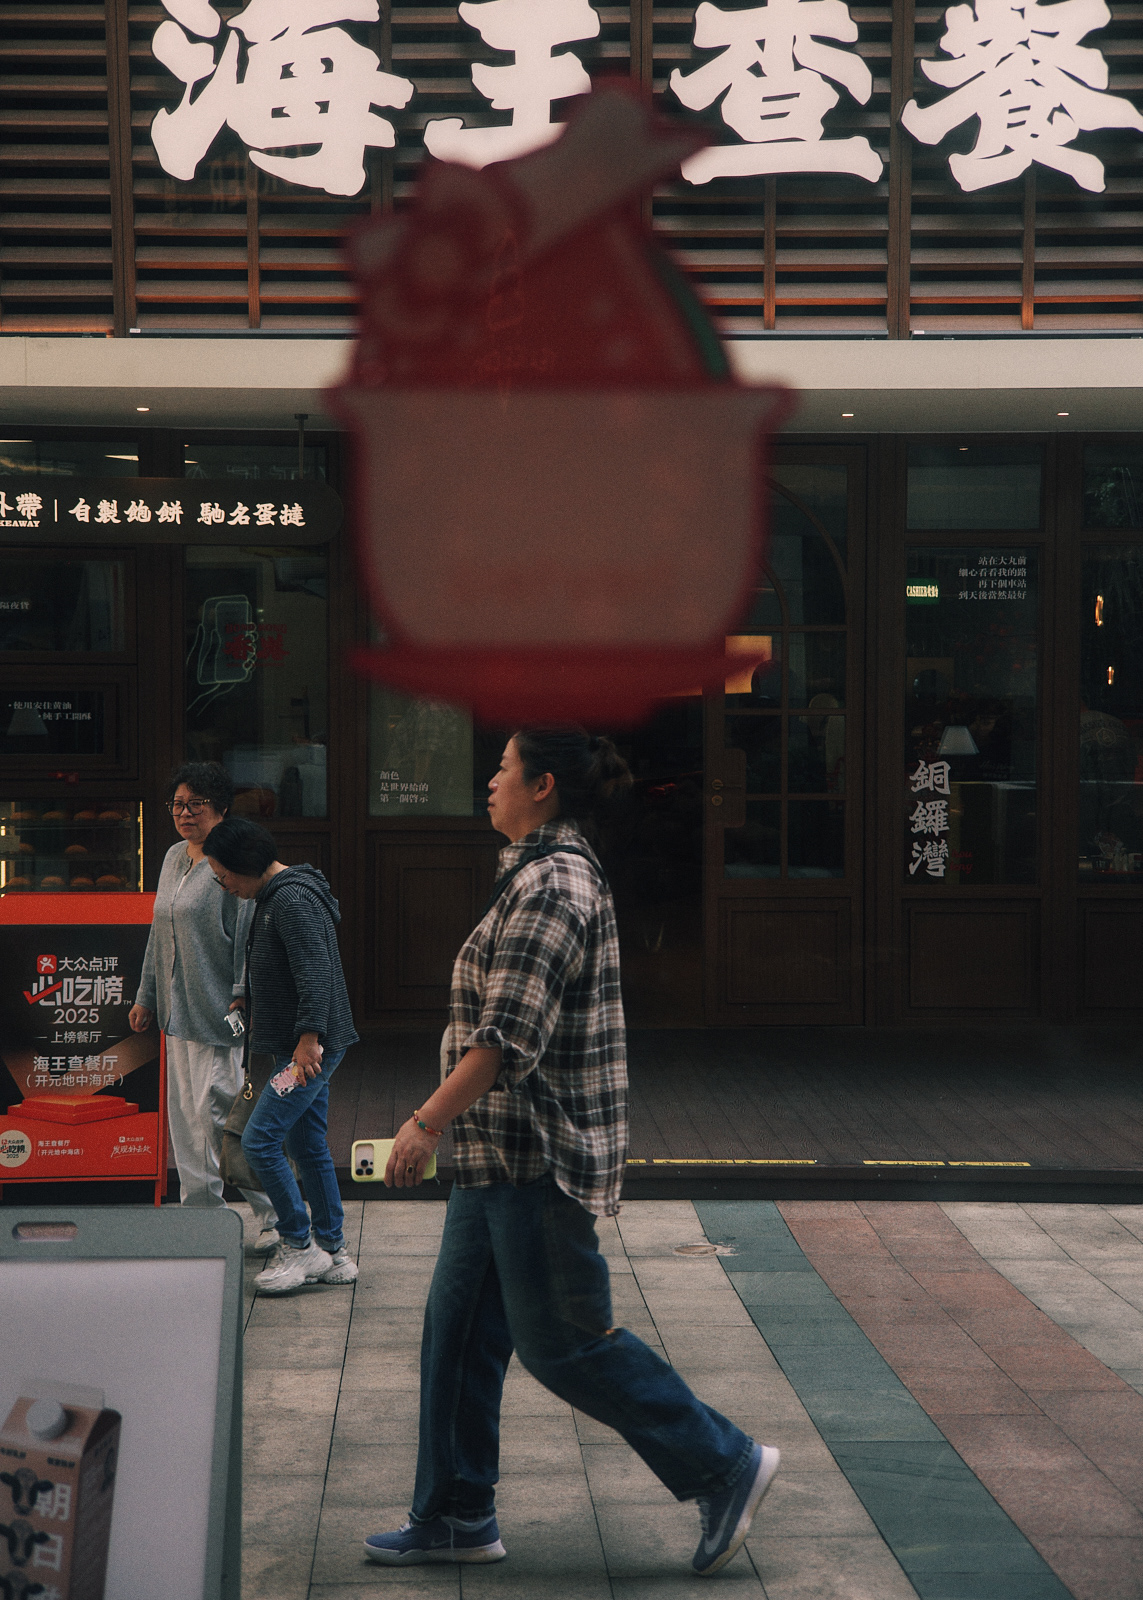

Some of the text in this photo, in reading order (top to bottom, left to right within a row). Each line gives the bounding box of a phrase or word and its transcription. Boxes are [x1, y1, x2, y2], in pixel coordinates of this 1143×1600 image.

[196, 501, 306, 527] 馳名蛋撻
[978, 556, 1027, 566] 站在大丸前
[978, 579, 1027, 589] 再下個車站
[908, 759, 951, 878] 銅鑼灣
[58, 956, 119, 972] 大众点评
[23, 975, 123, 1006] 必吃榜
[54, 1008, 99, 1024] 2025
[51, 1031, 102, 1044] 上榜餐厅
[33, 1055, 118, 1072] 海王查餐厅
